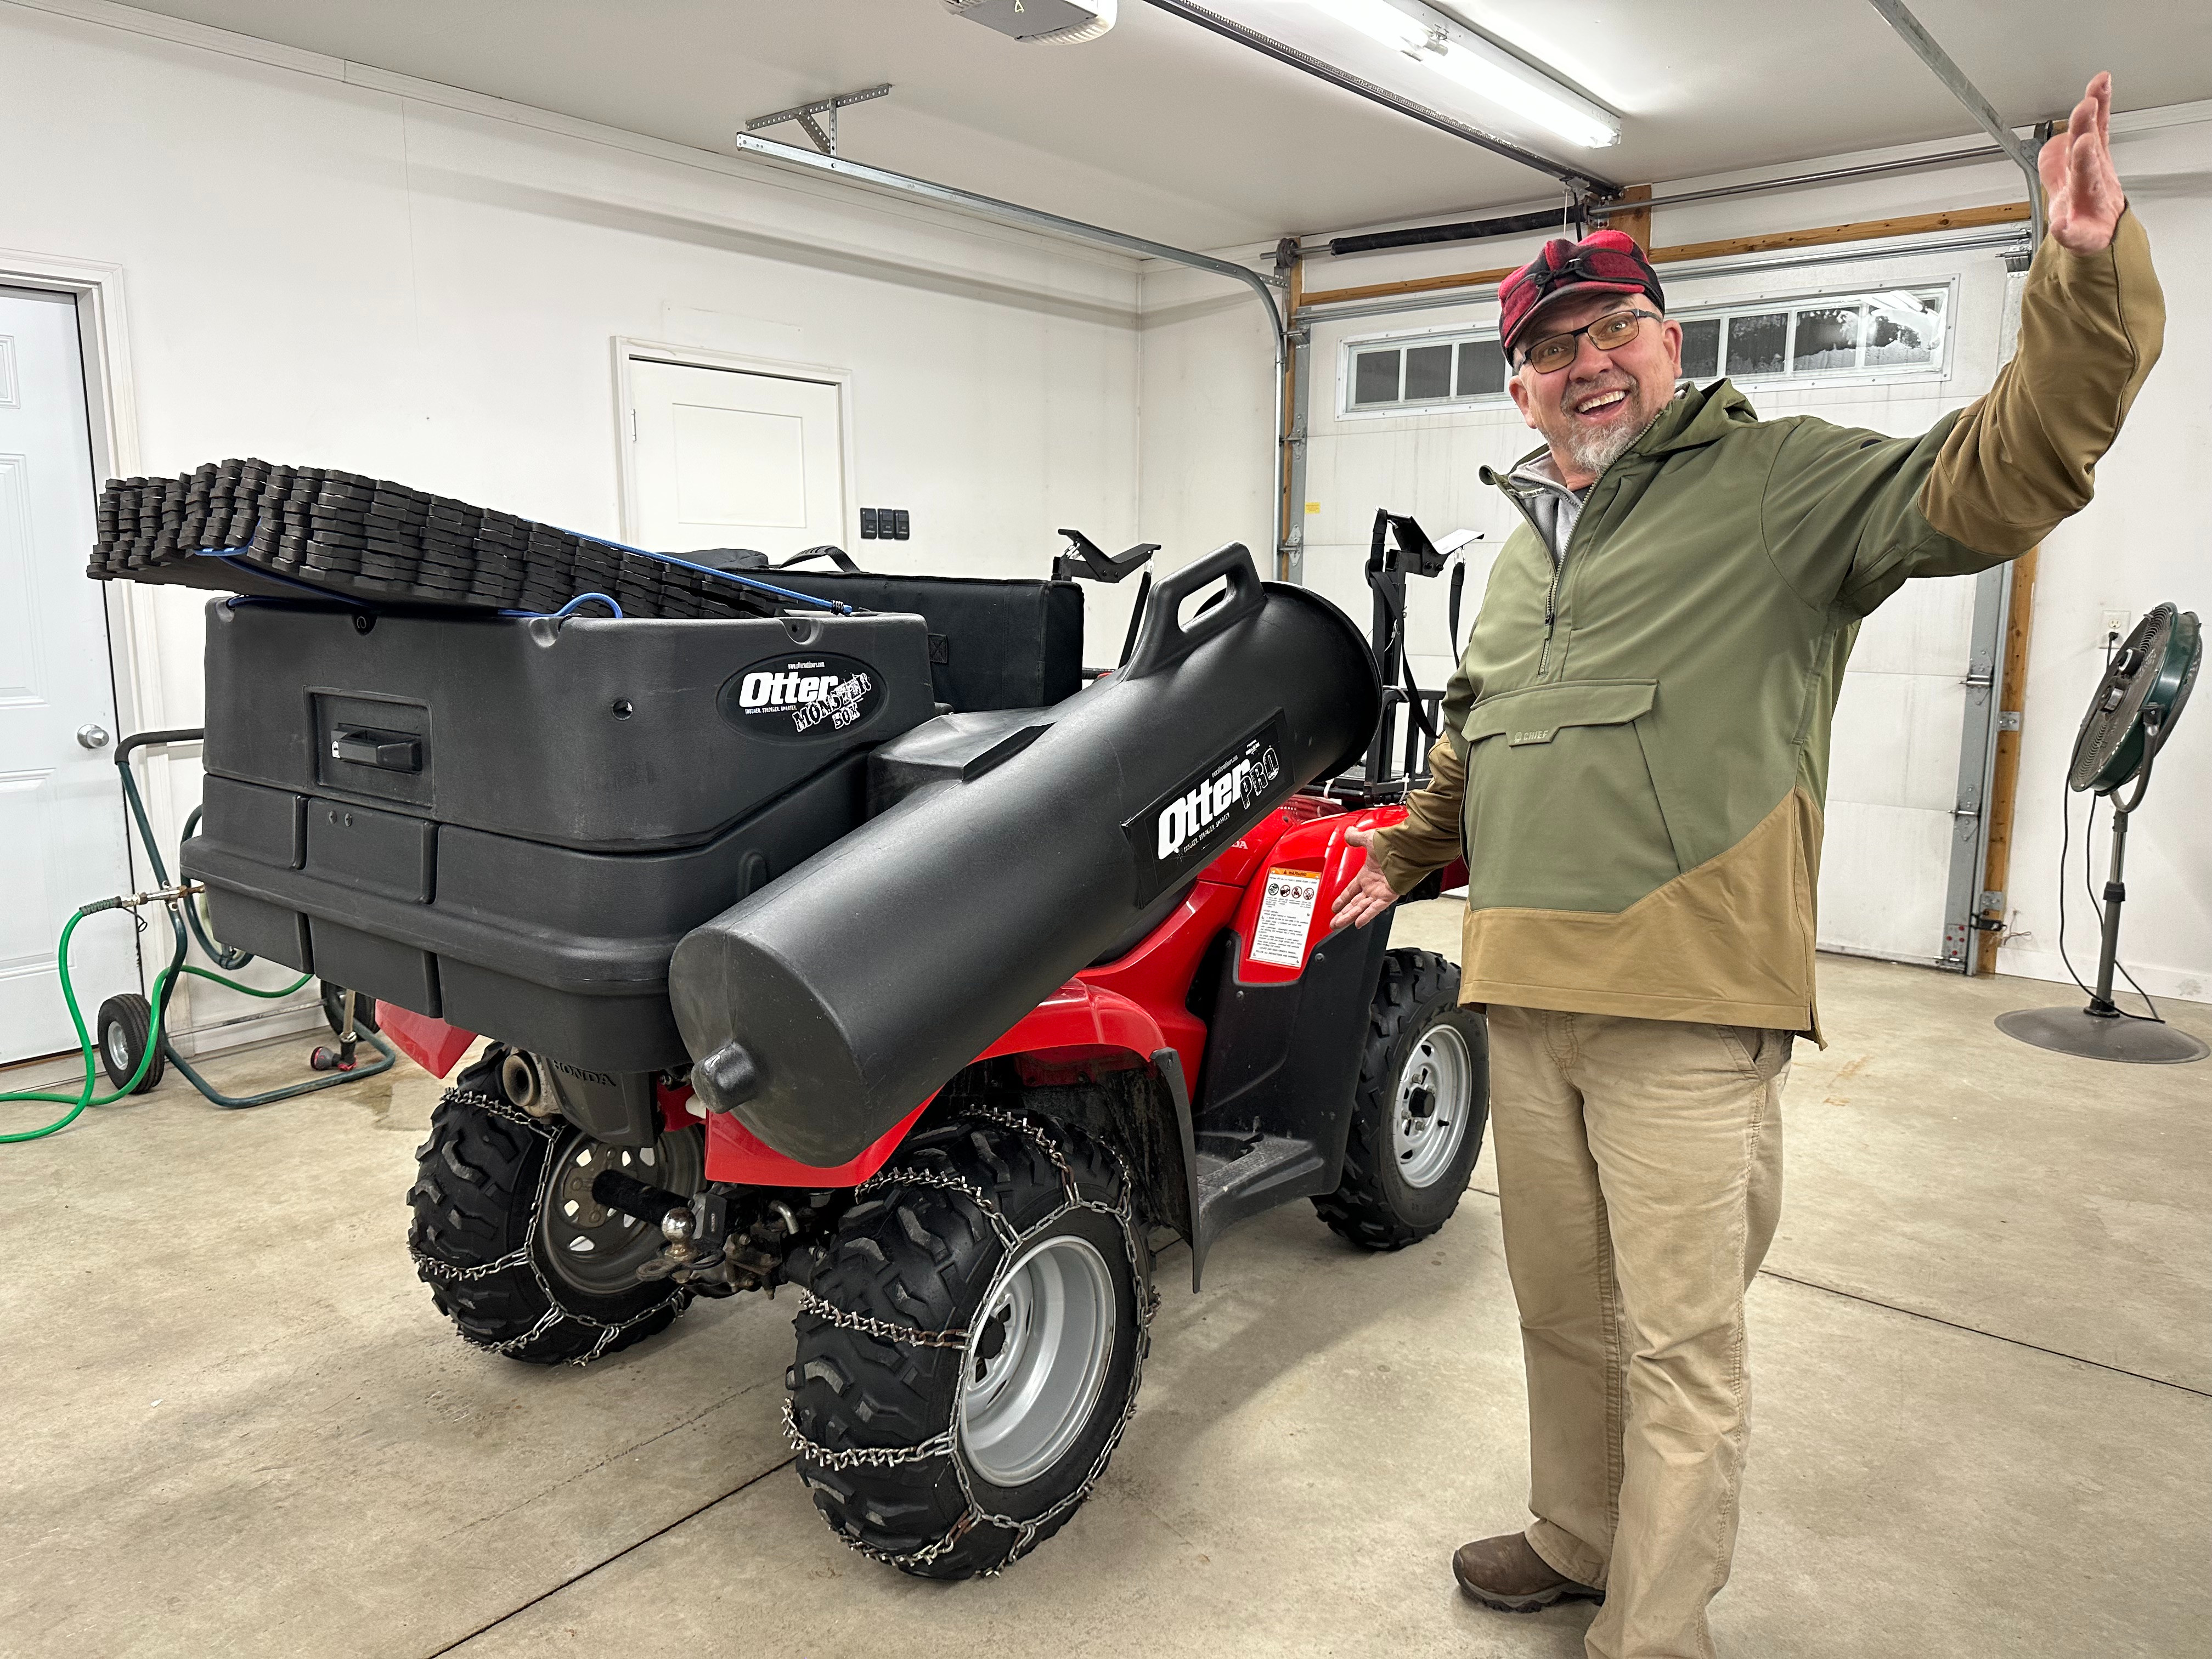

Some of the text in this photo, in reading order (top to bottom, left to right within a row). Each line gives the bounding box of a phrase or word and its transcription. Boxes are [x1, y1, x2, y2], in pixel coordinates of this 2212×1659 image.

[739, 672, 838, 707] Otter
[792, 673, 871, 732] MONSTER
[832, 702, 860, 730] BOX
[1523, 730, 1548, 741] CHIEF
[1240, 747, 1279, 809] PRO
[1158, 759, 1250, 860] Otter
[553, 1058, 616, 1086] HONDA
